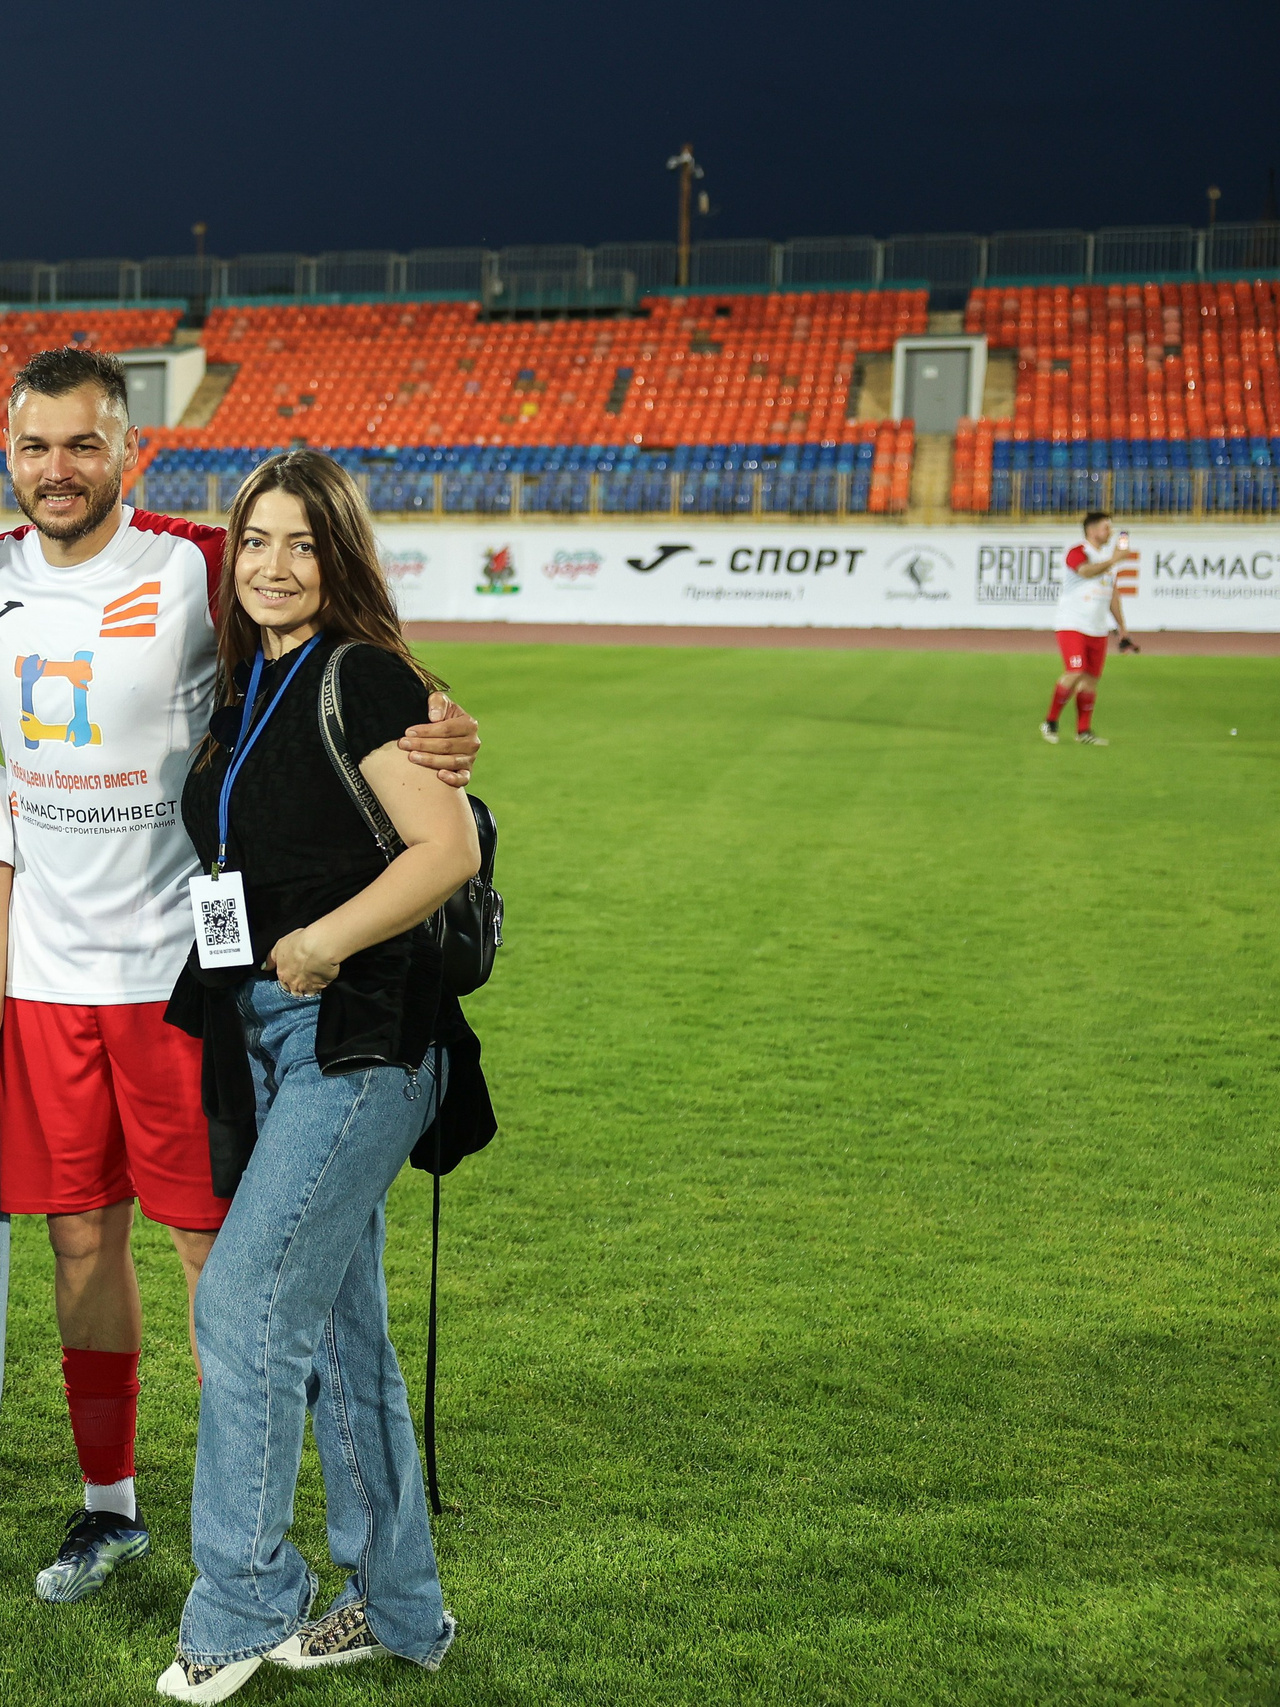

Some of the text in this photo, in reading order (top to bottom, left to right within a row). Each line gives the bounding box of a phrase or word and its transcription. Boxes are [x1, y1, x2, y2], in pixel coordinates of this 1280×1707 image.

[729, 547, 867, 575] СПОРТ
[978, 545, 1065, 585] PRIDE
[1154, 551, 1280, 580] КАМАС
[324, 685, 335, 716] DIOR
[46, 773, 54, 788] и
[54, 769, 102, 794] боремся
[104, 769, 148, 789] вместе
[341, 752, 397, 840] CHRISTIAN DIOR
[129, 818, 176, 832] КОМПАНИЯ
